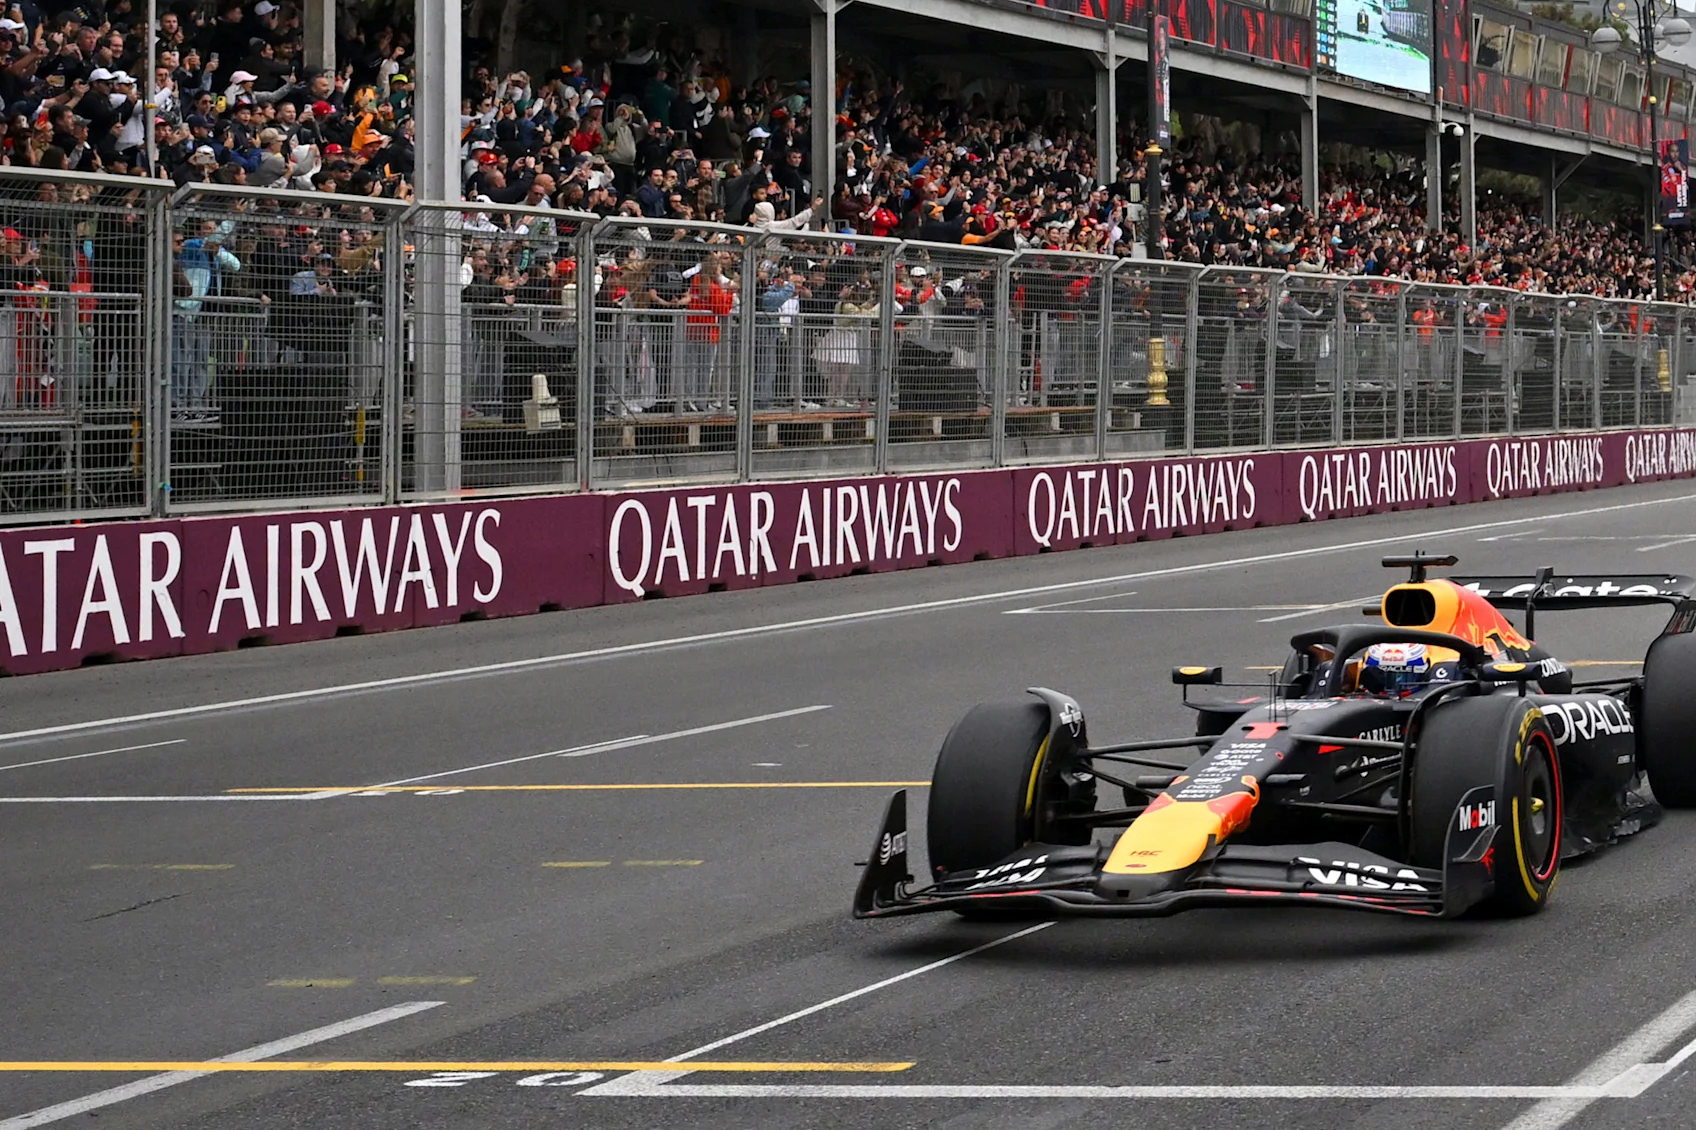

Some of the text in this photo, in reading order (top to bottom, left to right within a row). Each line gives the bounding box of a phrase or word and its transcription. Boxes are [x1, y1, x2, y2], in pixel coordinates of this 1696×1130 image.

[1300, 446, 1457, 520] QATAR AIRWAYS
[1487, 438, 1603, 497] QATAR AIRWAYS
[1625, 434, 1666, 482] QATAR
[1028, 458, 1255, 546] QATAR AIRWAYS
[609, 478, 962, 597] QATAR AIRWAYS
[209, 509, 503, 633] AIRWAYS
[1359, 724, 1401, 742] CARLYLE
[1540, 699, 1634, 746] ORACLE
[1459, 800, 1495, 831] Mobil
[1298, 857, 1428, 891] VISA
